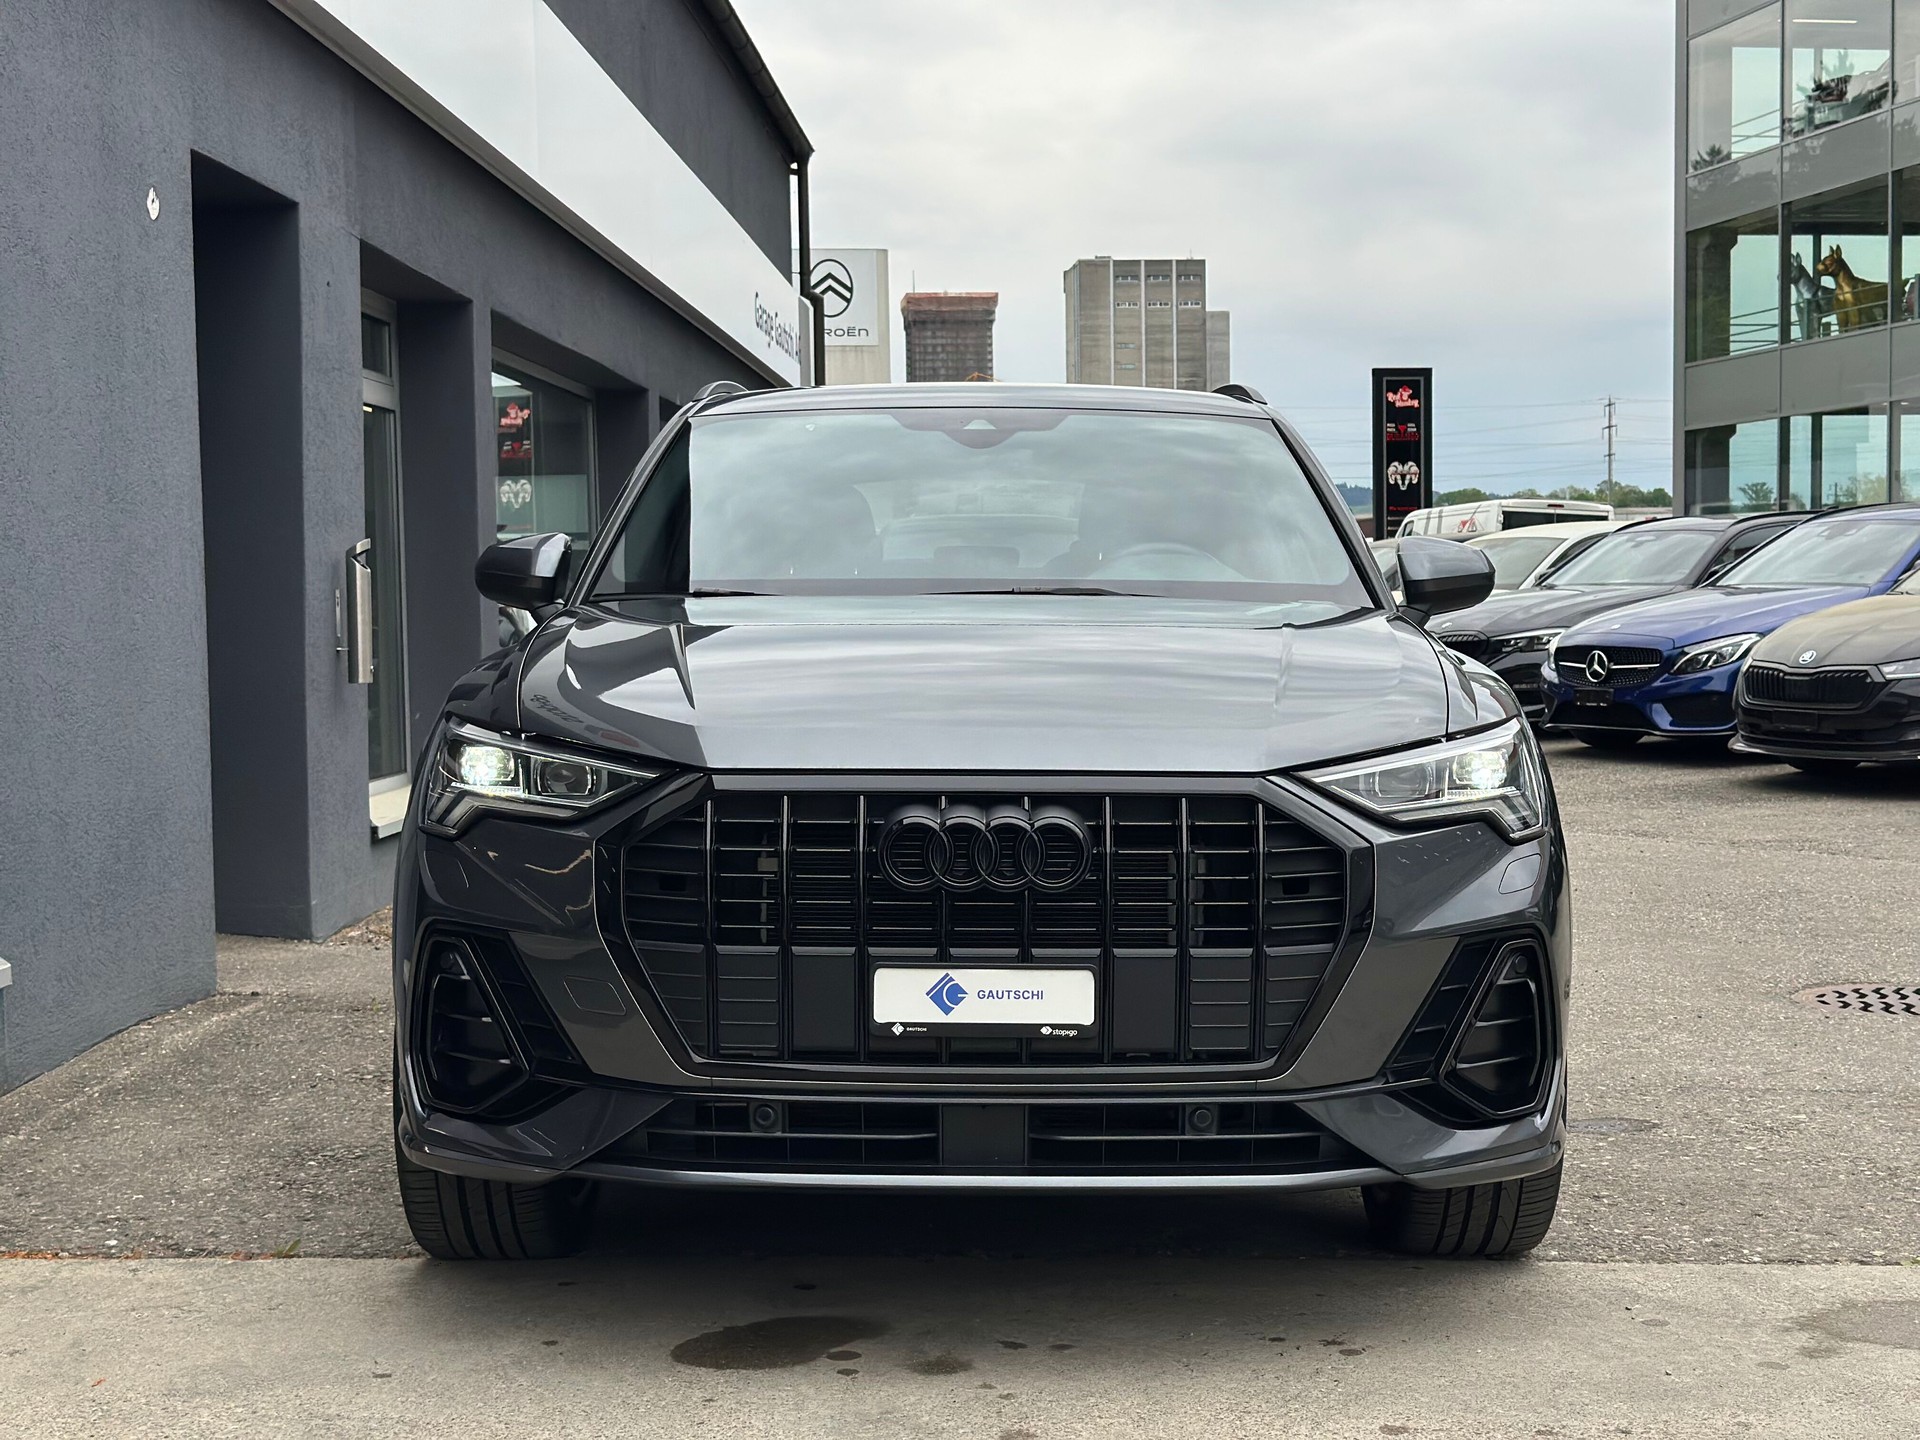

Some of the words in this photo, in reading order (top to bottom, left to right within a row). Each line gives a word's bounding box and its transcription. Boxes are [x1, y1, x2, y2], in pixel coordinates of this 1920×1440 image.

[755, 291, 774, 349] Garage
[824, 326, 869, 337] ROËN
[977, 989, 1044, 1000] GAUTSCHI
